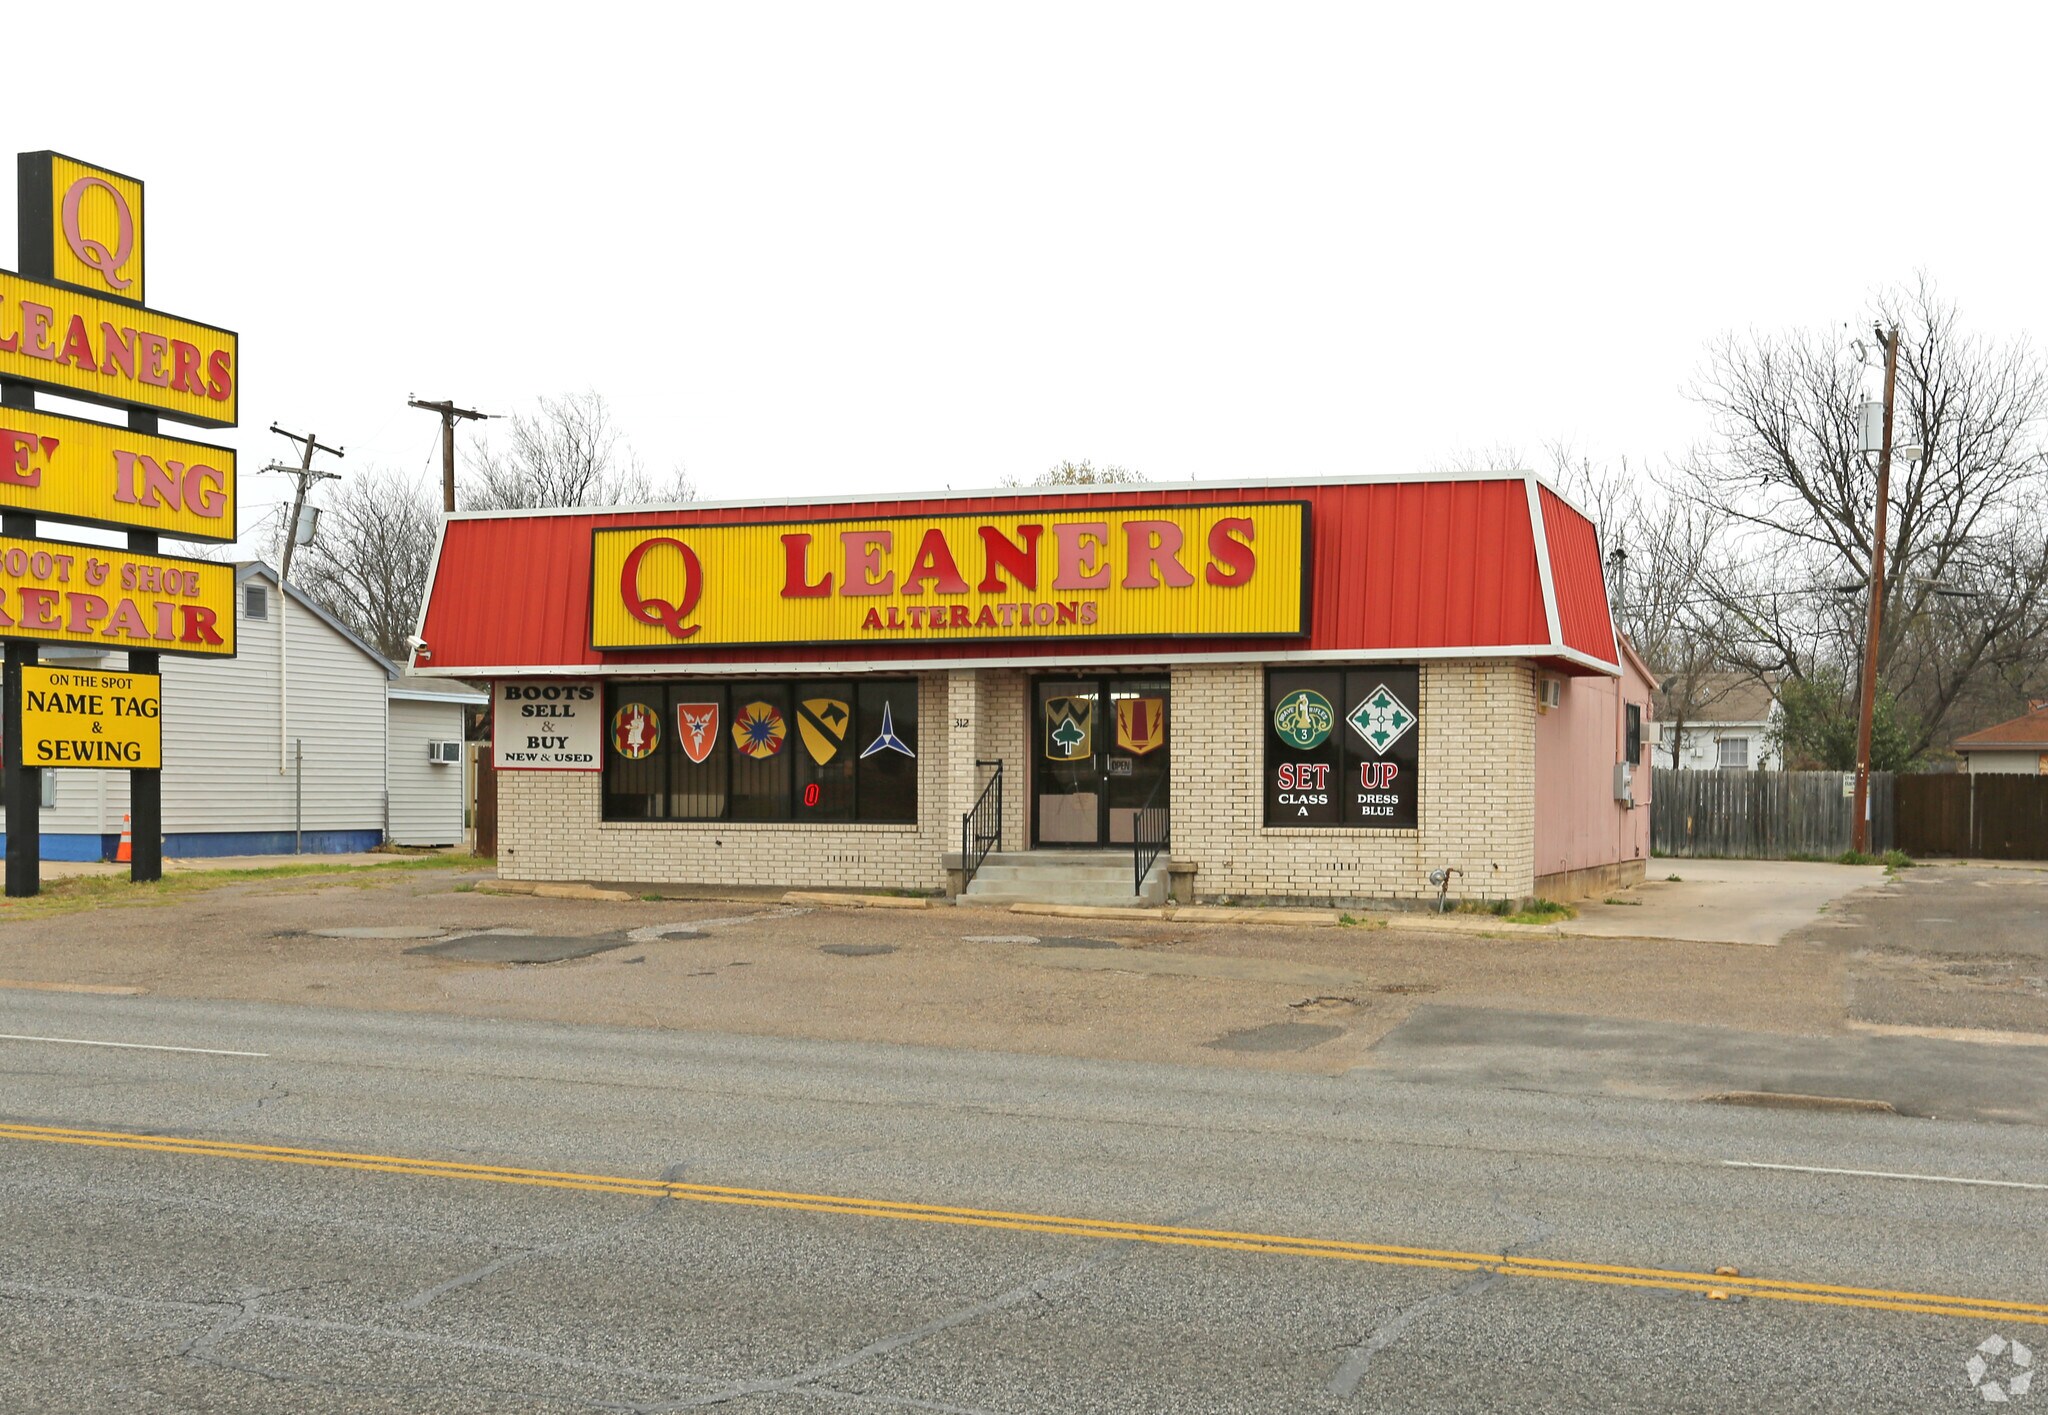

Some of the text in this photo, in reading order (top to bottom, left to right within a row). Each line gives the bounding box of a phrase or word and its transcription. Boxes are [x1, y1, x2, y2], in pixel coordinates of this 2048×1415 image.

[61, 176, 134, 290] Q
[113, 449, 228, 518] ING
[0, 547, 200, 598] OOT & SHOE
[620, 517, 1256, 639] Q LEANERS
[862, 601, 1098, 630] ALTERATIONS
[50, 673, 133, 690] ON THE SPOT
[504, 686, 595, 700] BOOTS
[26, 690, 159, 718] NAME TAG
[521, 704, 576, 718] SELL
[92, 721, 103, 734] &
[541, 720, 556, 733] &
[954, 718, 969, 729] 312
[1301, 729, 1308, 740] 3
[527, 736, 569, 749] BUY
[37, 739, 141, 762] SEWING
[505, 752, 593, 763] NEW & USED
[1111, 760, 1131, 771] OPEN
[1277, 761, 1399, 790] SET UP
[1278, 794, 1328, 805] CLASS
[1357, 794, 1399, 804] DRESS
[1297, 806, 1309, 816] A
[1362, 806, 1394, 816] BLUE
